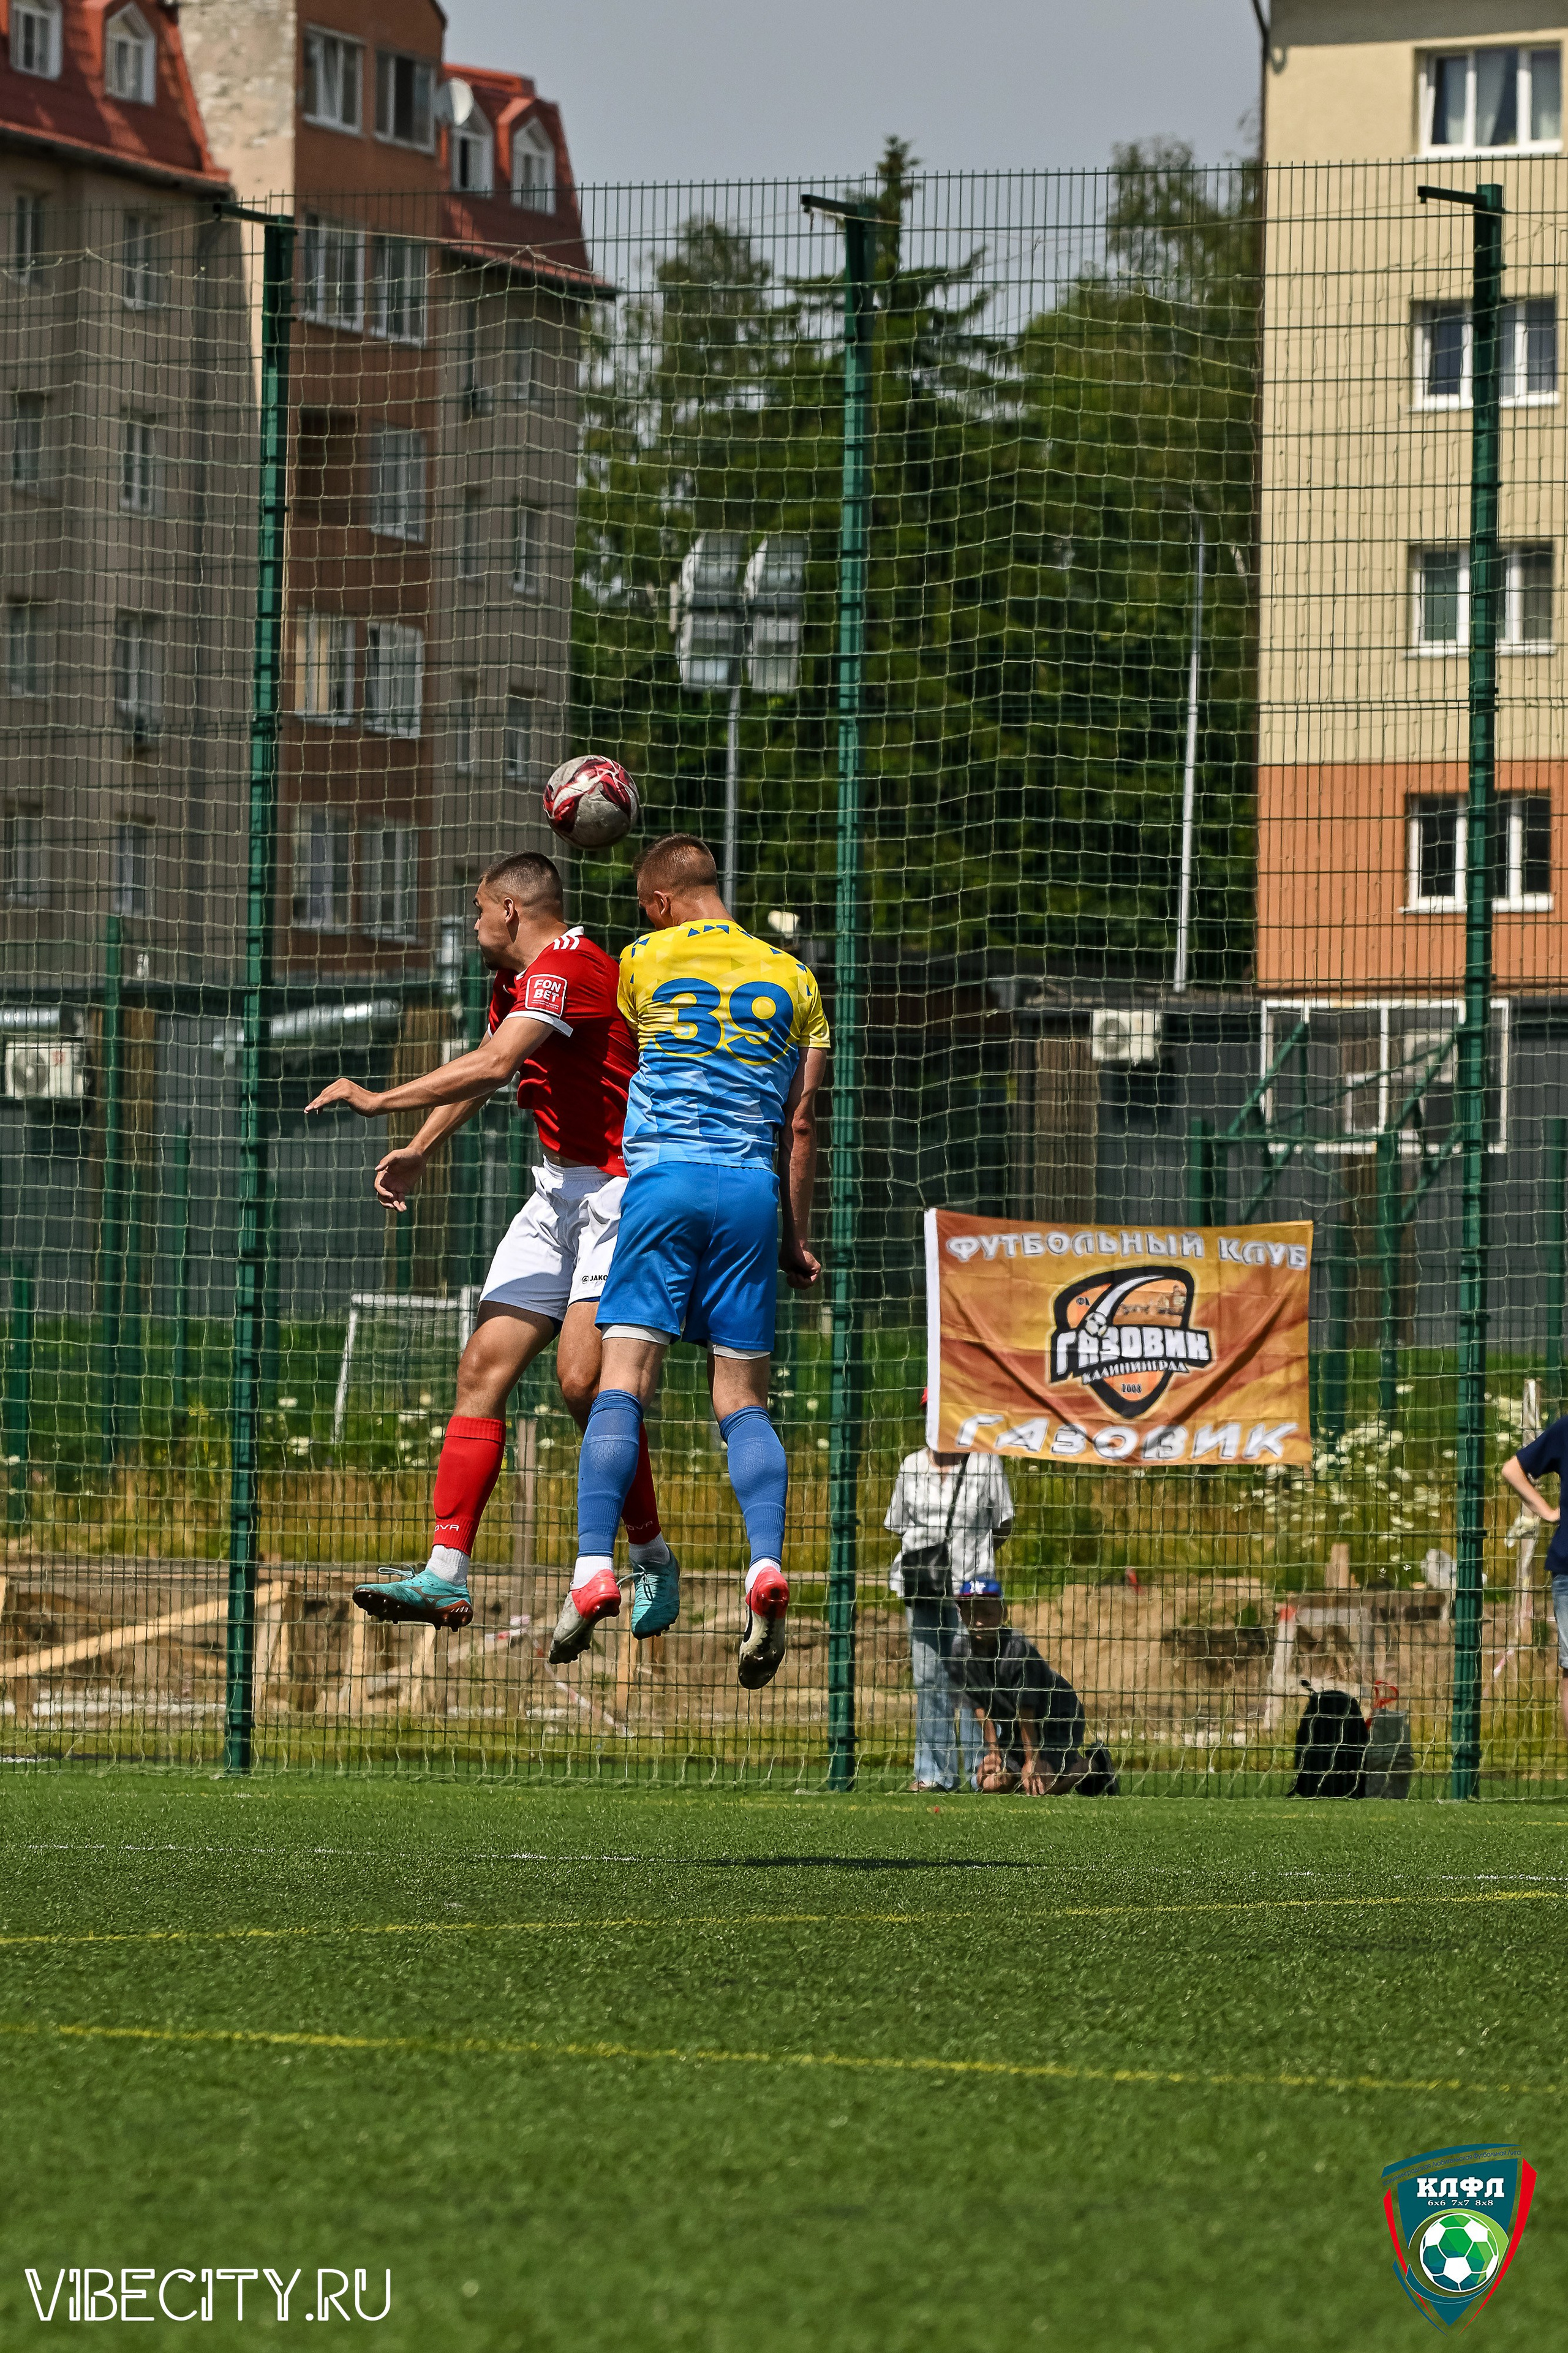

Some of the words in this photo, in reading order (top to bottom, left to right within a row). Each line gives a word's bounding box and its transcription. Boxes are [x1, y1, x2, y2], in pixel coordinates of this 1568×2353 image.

[533, 979, 562, 992] FON
[533, 989, 560, 1002] BET
[651, 977, 794, 1066] 39
[946, 1231, 1204, 1262] ФУТБОЛЬНЫЙ
[1218, 1237, 1308, 1270] КЛУБ
[1056, 1326, 1209, 1375] ГАЗОВИК
[956, 1413, 1300, 1462] ГАЗОВИК
